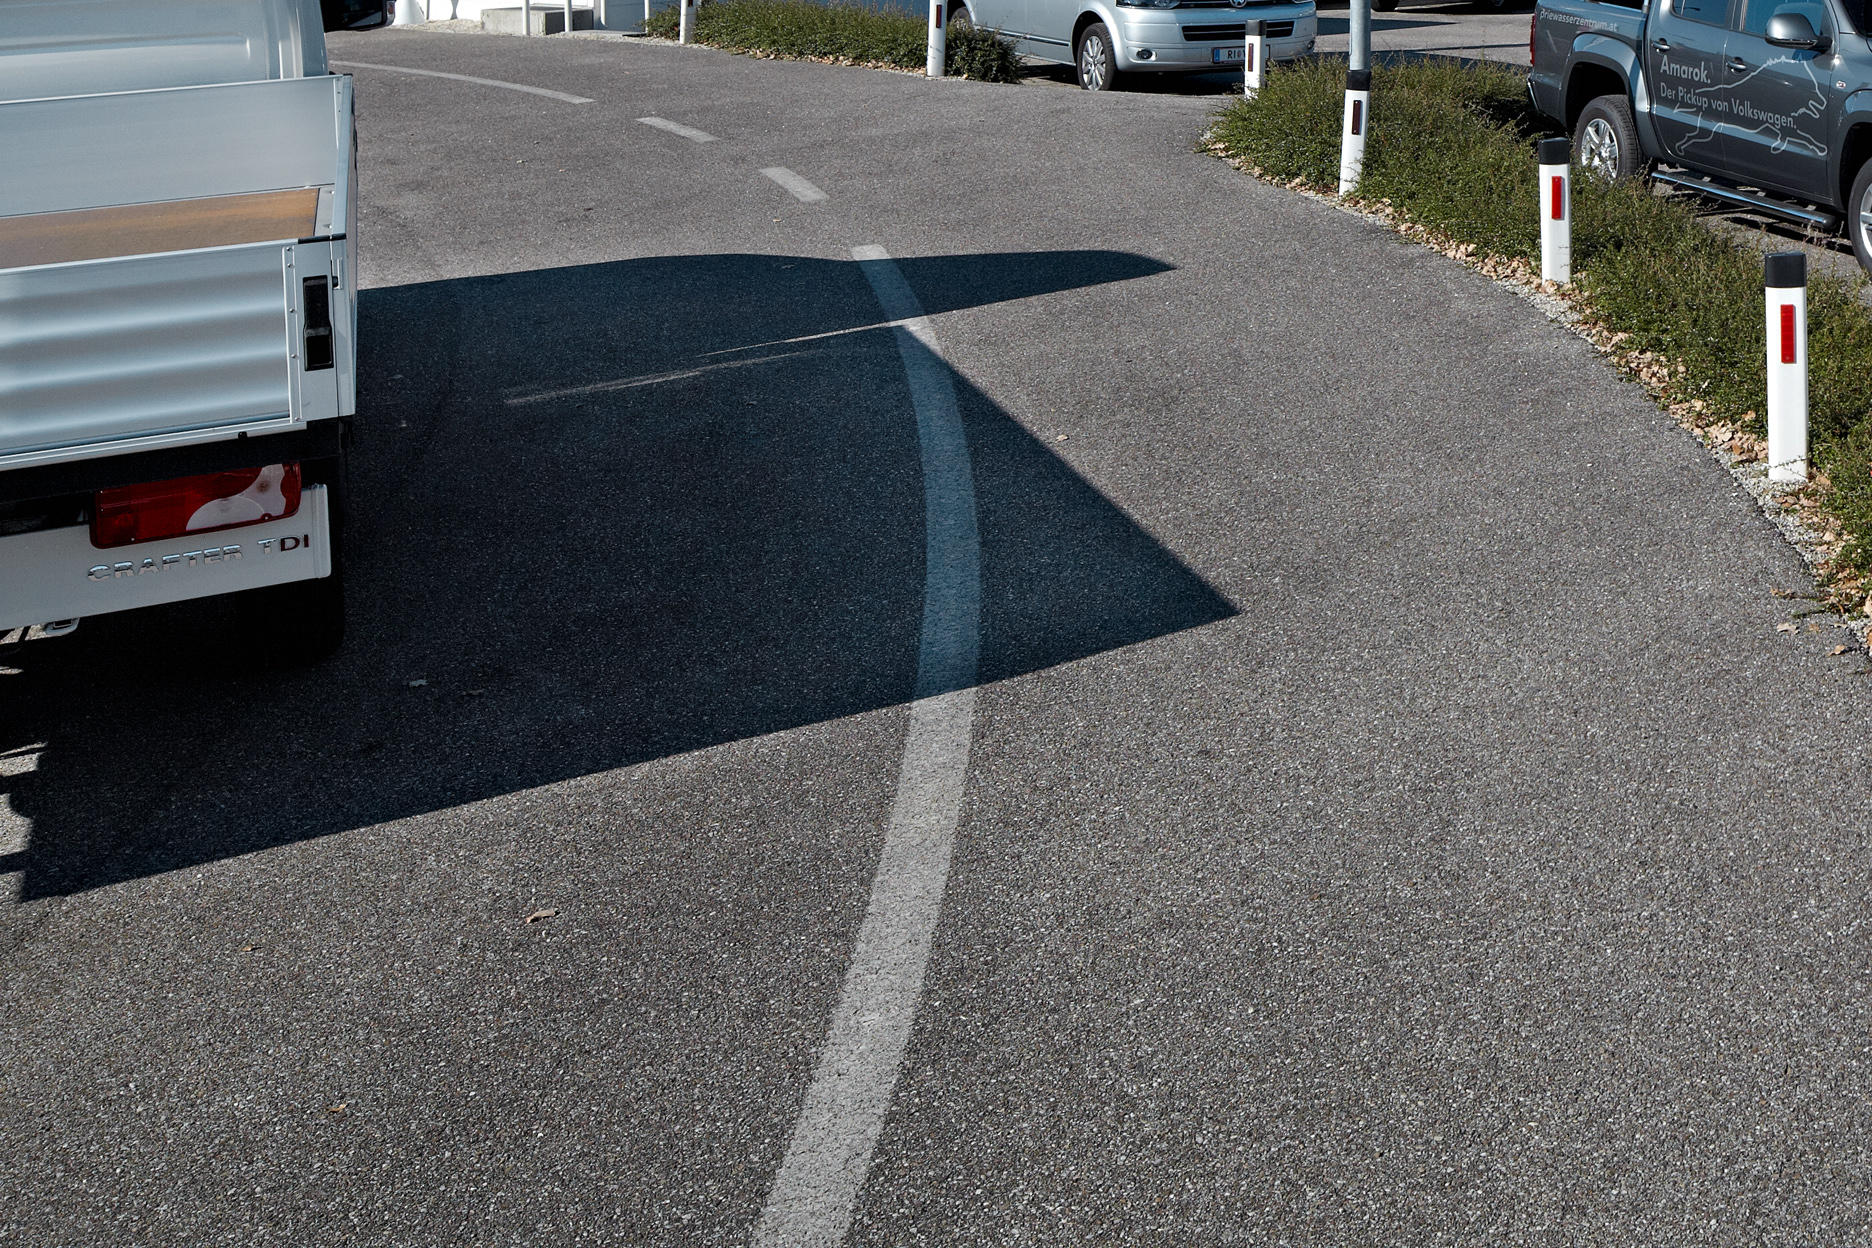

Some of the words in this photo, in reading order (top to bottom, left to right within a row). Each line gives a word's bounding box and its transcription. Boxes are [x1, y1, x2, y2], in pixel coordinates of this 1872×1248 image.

[1660, 54, 1711, 84] Amarok.
[1660, 83, 1676, 99] Der
[1678, 86, 1708, 110] Pickup
[1711, 99, 1729, 112] von
[1731, 98, 1797, 129] Volkswagen.
[87, 544, 243, 582] CRAFTER
[257, 534, 310, 555] TDI
